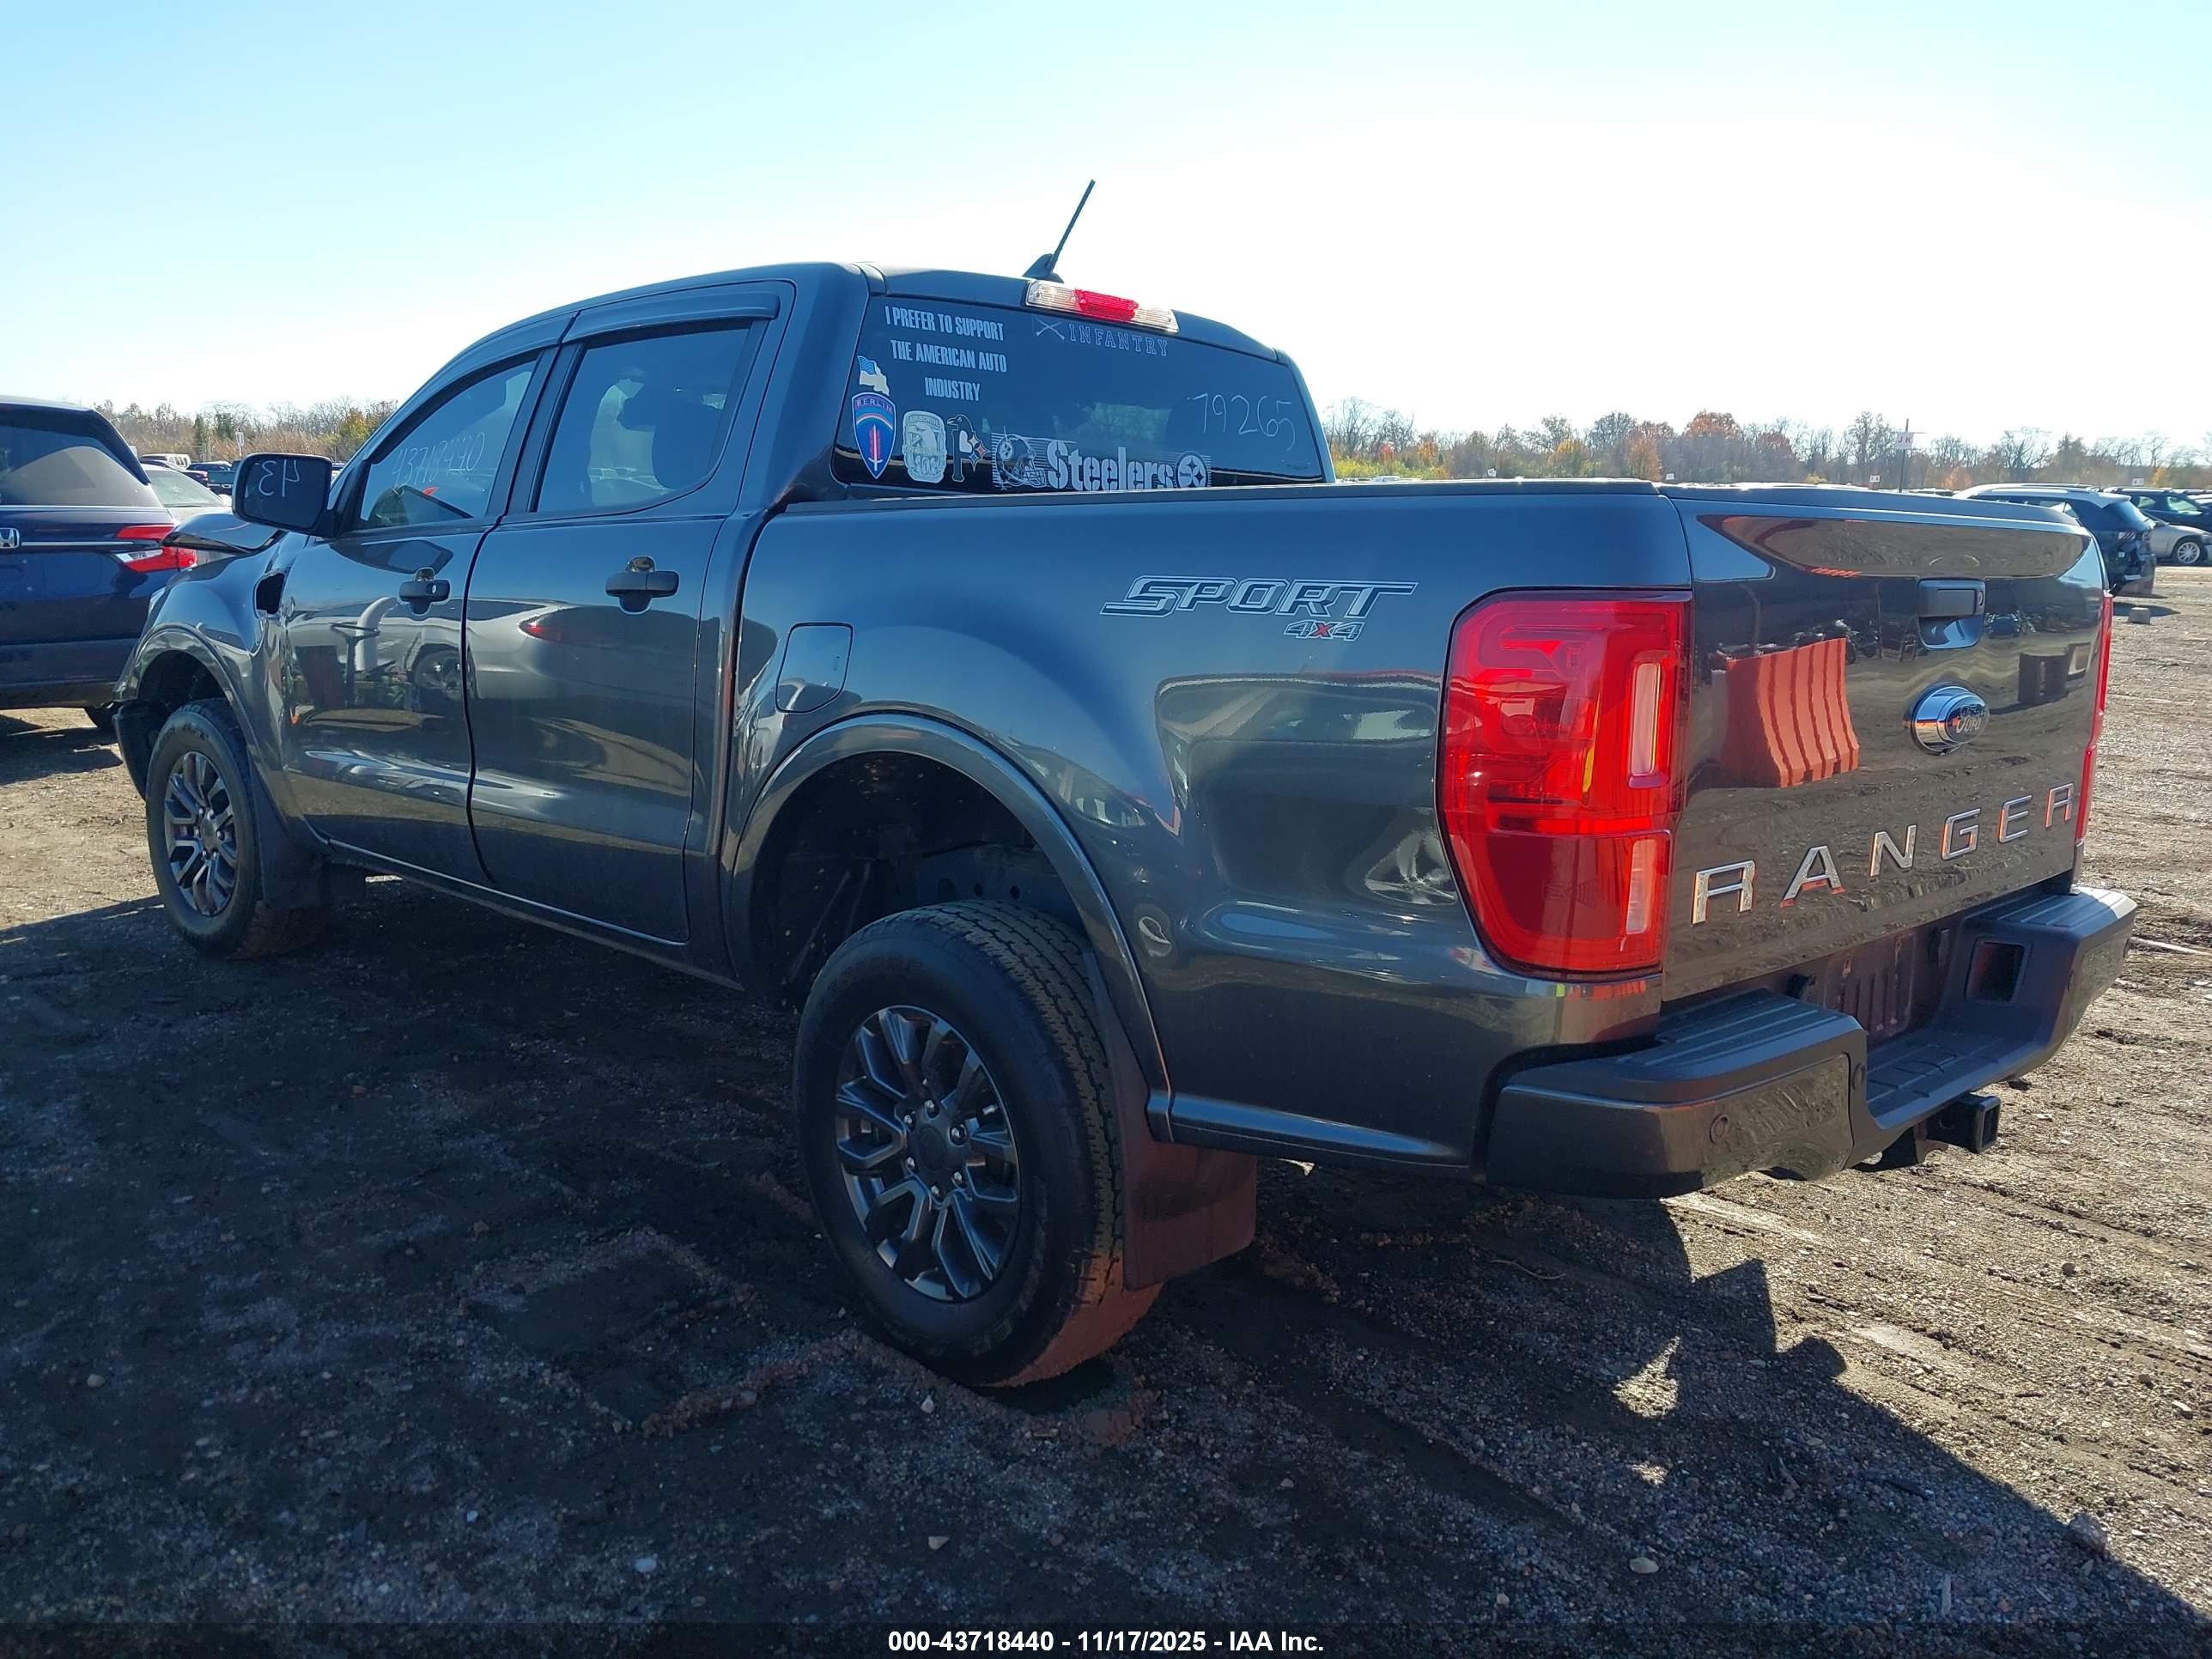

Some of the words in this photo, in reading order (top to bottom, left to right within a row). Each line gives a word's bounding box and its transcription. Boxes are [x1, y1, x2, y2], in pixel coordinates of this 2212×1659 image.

[884, 306, 890, 325] I
[892, 307, 936, 331] PREFER
[938, 313, 952, 333] TO
[955, 316, 1004, 341] SUPPORT
[1068, 323, 1168, 356] INFANTRY
[890, 339, 913, 361] THE
[915, 343, 976, 369] AMERICAN
[978, 351, 1007, 373] AUTO
[856, 398, 893, 412] BERLIN
[924, 377, 981, 401] INDUSTRY
[1186, 392, 1296, 452] 79265
[1047, 440, 1174, 491] Steelers
[1100, 575, 1419, 617] SPORT
[1692, 782, 2075, 925] RANGER
